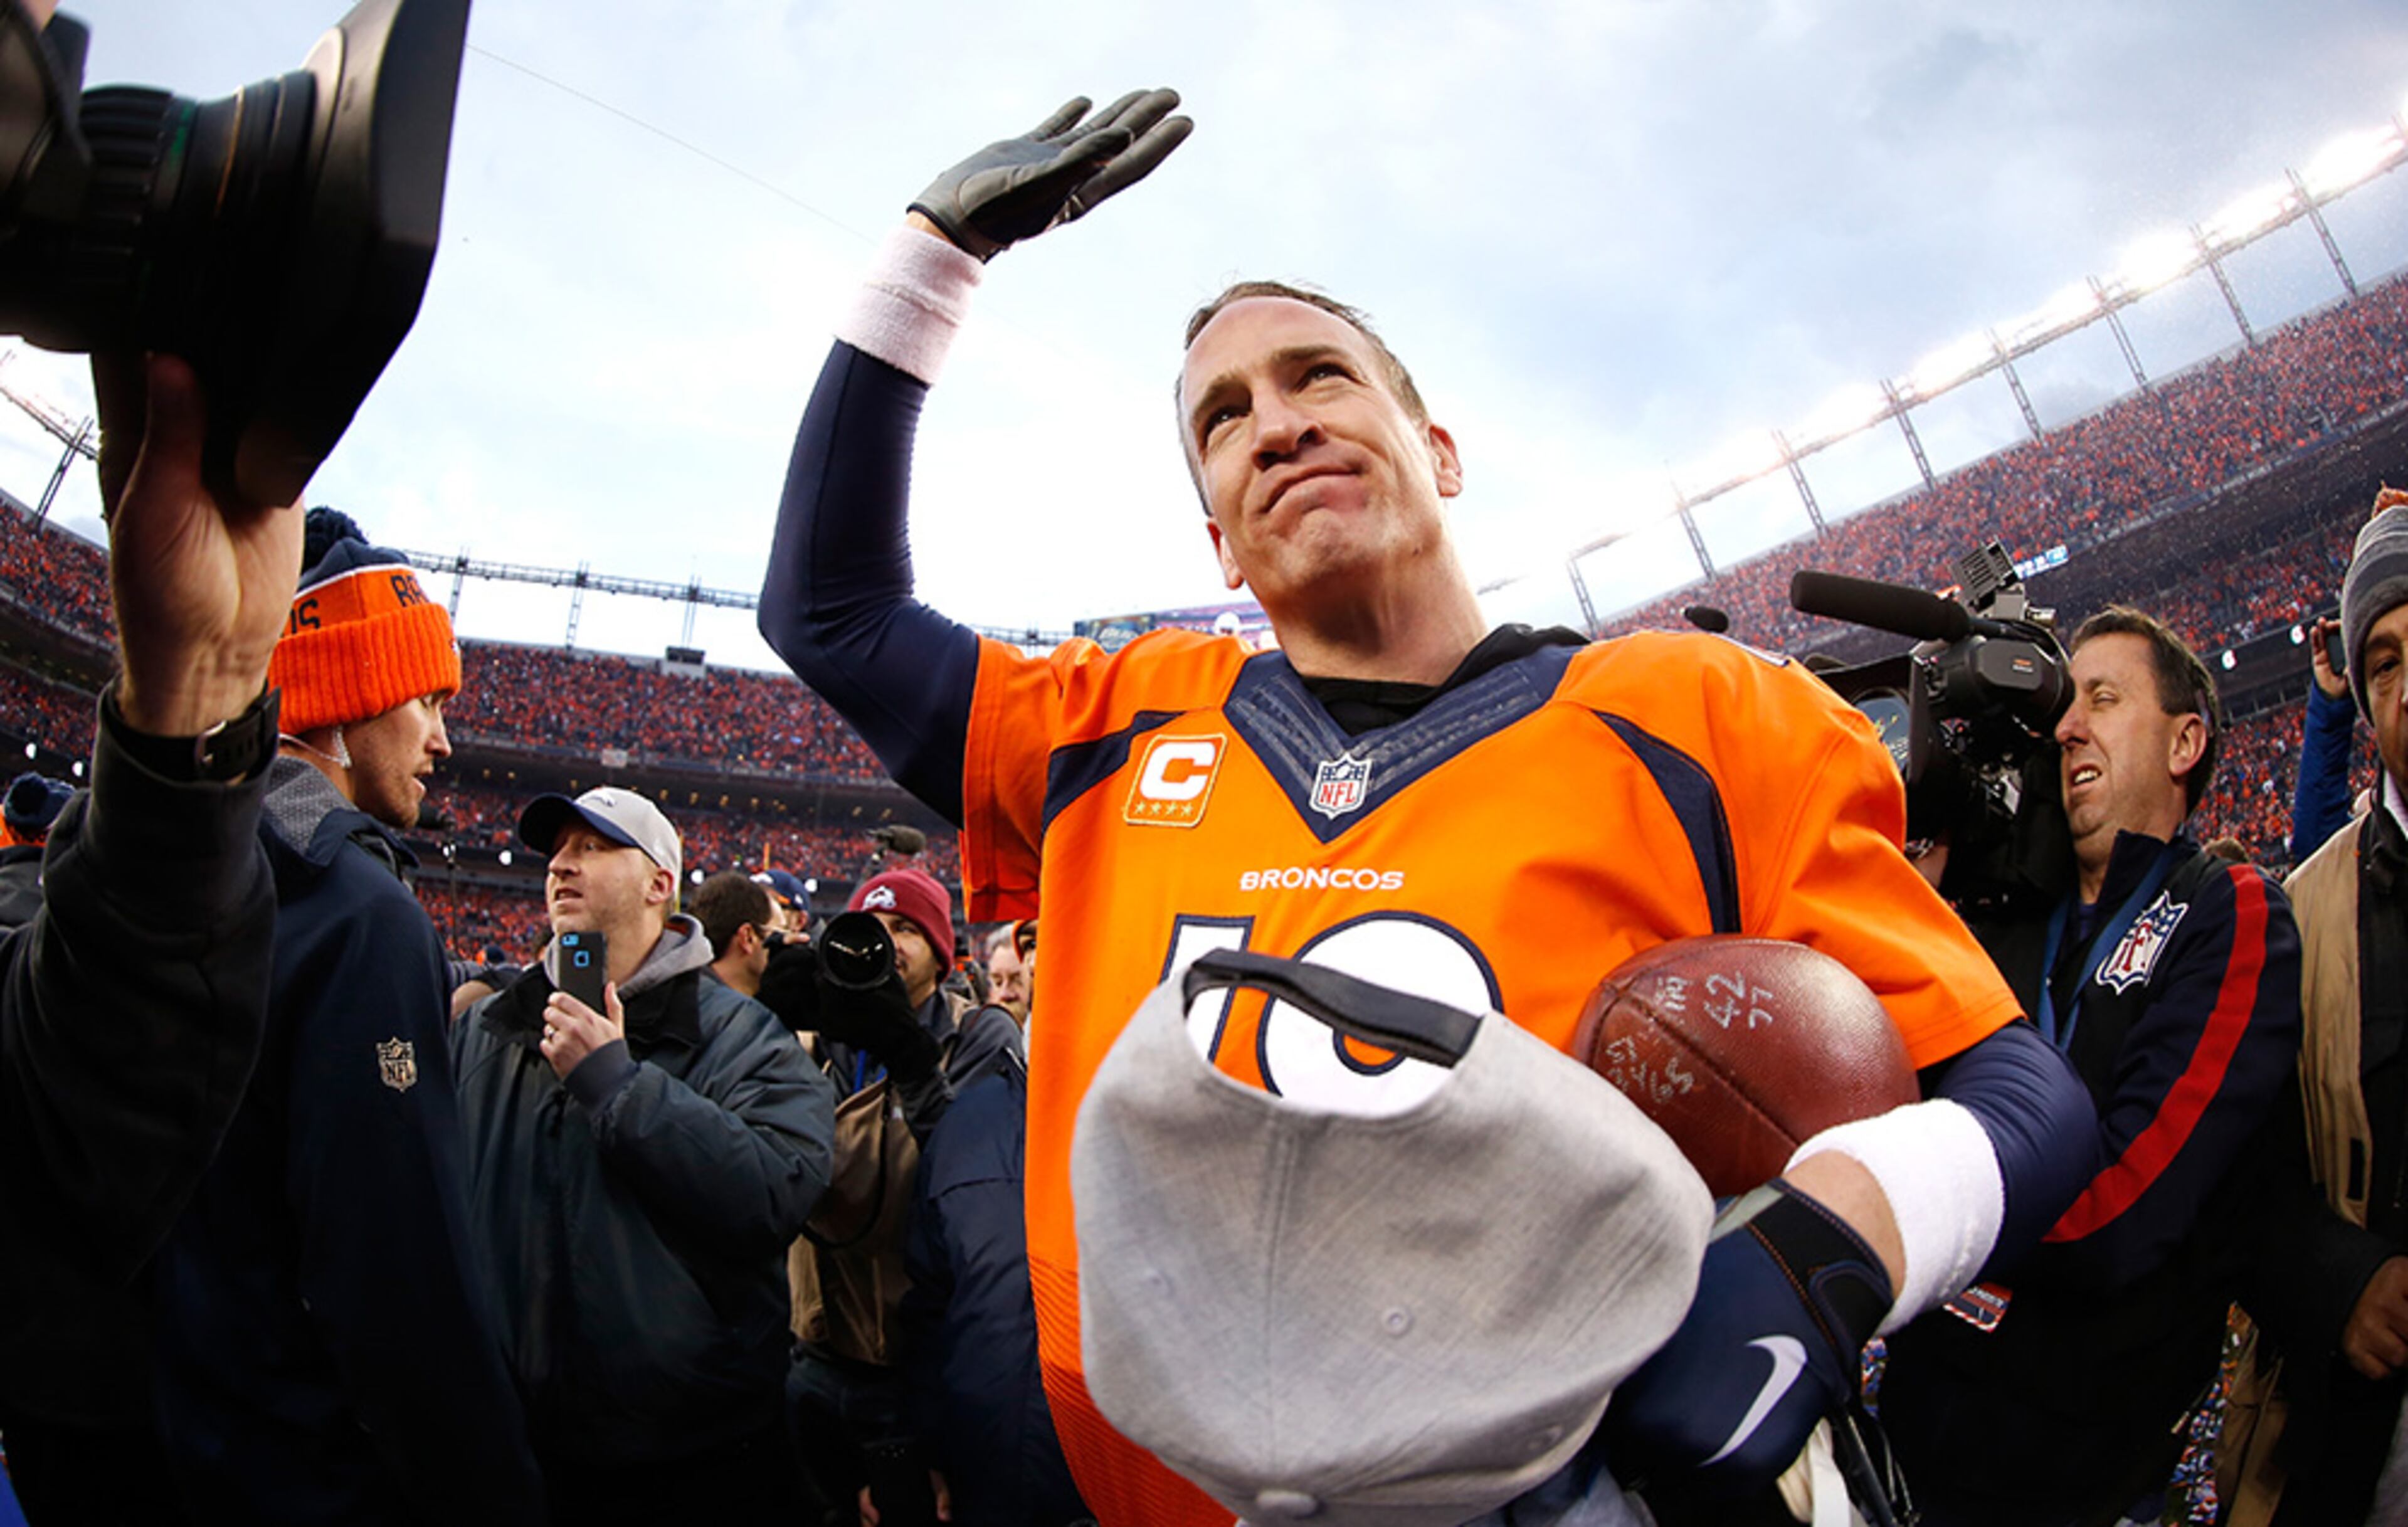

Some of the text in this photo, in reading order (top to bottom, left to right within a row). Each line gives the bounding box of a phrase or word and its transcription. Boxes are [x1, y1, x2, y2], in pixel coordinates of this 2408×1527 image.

[1139, 741, 1216, 801] C
[1319, 781, 1358, 806] NFL
[1239, 866, 1405, 890] BRONCOS
[1703, 970, 1745, 1029] 42
